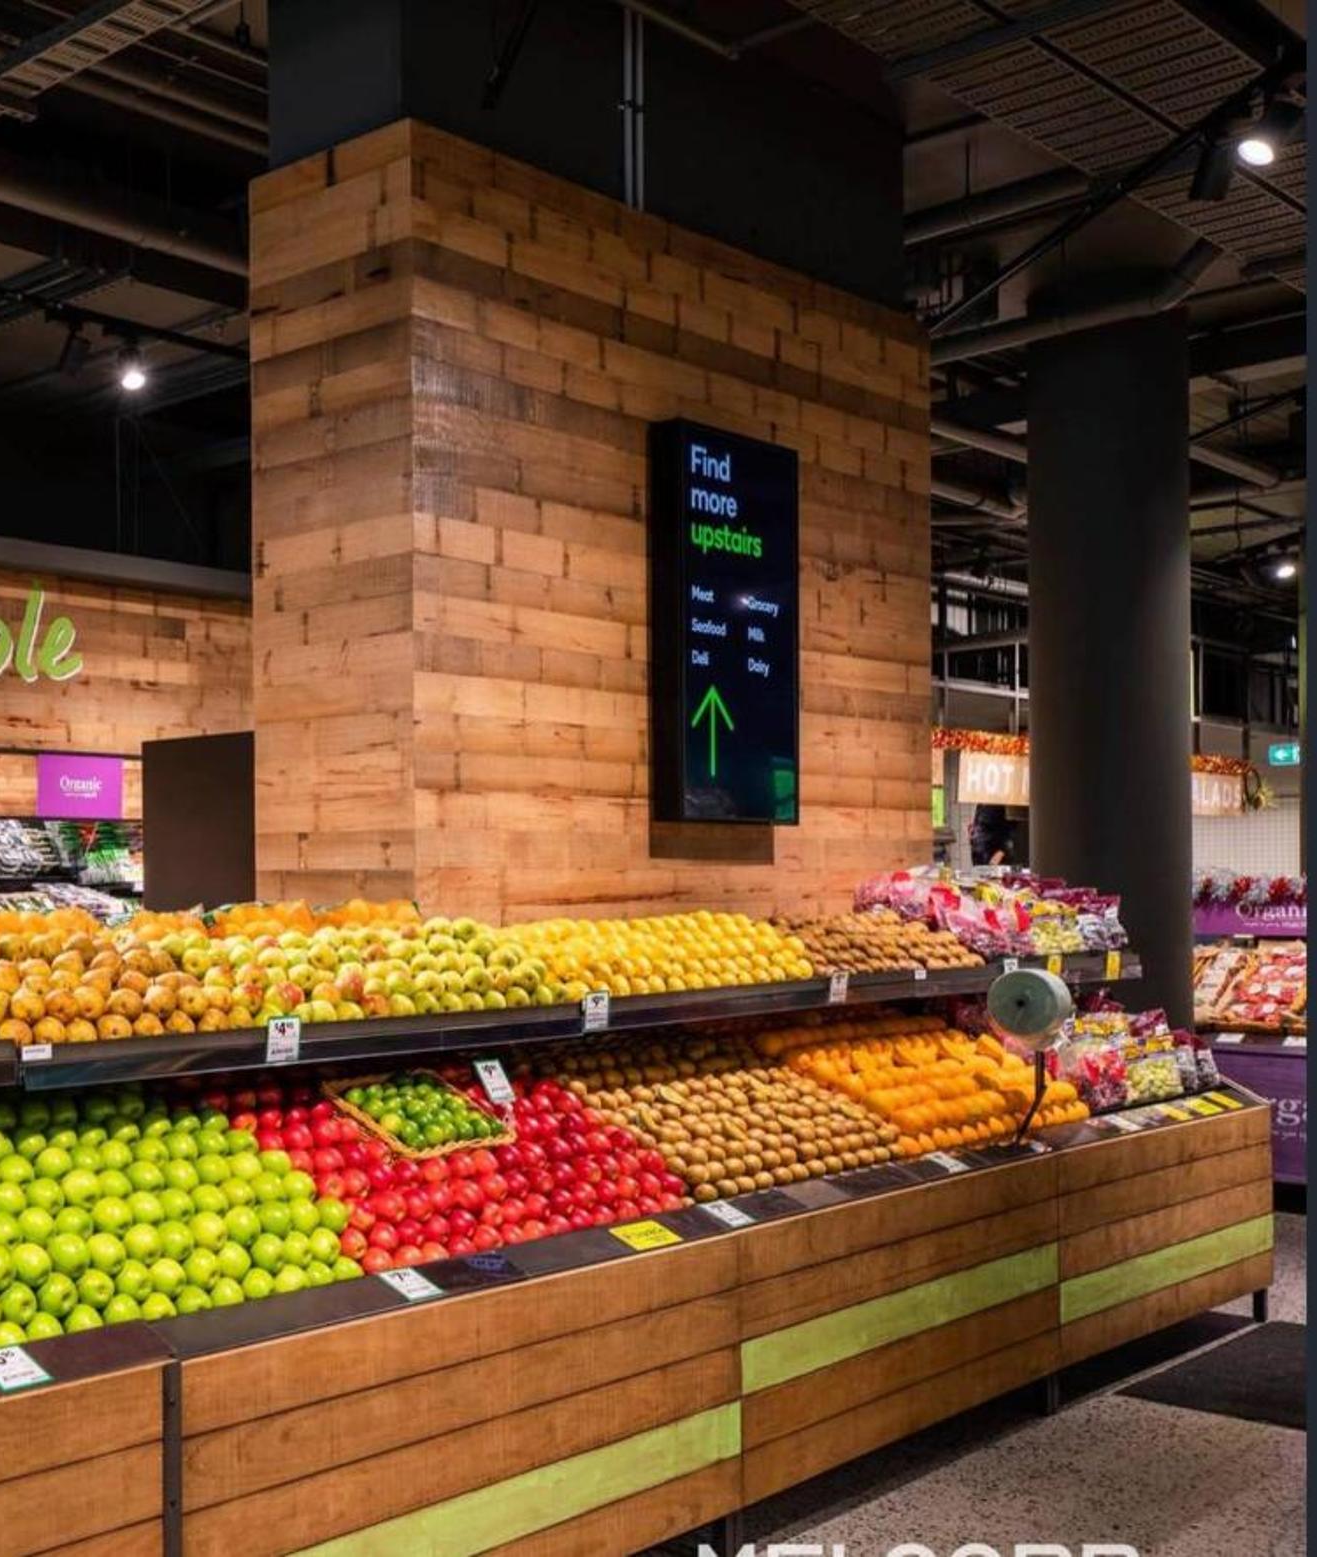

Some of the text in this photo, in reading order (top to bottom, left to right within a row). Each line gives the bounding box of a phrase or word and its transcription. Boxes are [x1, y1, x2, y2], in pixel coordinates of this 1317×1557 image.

[691, 444, 731, 482] Find
[691, 487, 738, 518] more
[691, 523, 763, 558] upstairs
[691, 584, 779, 618] Meat Grocery
[691, 617, 765, 642] Seafood Milk
[691, 649, 770, 678] Deli Dairy
[60, 774, 103, 793] Organic
[967, 760, 1015, 796] HOT
